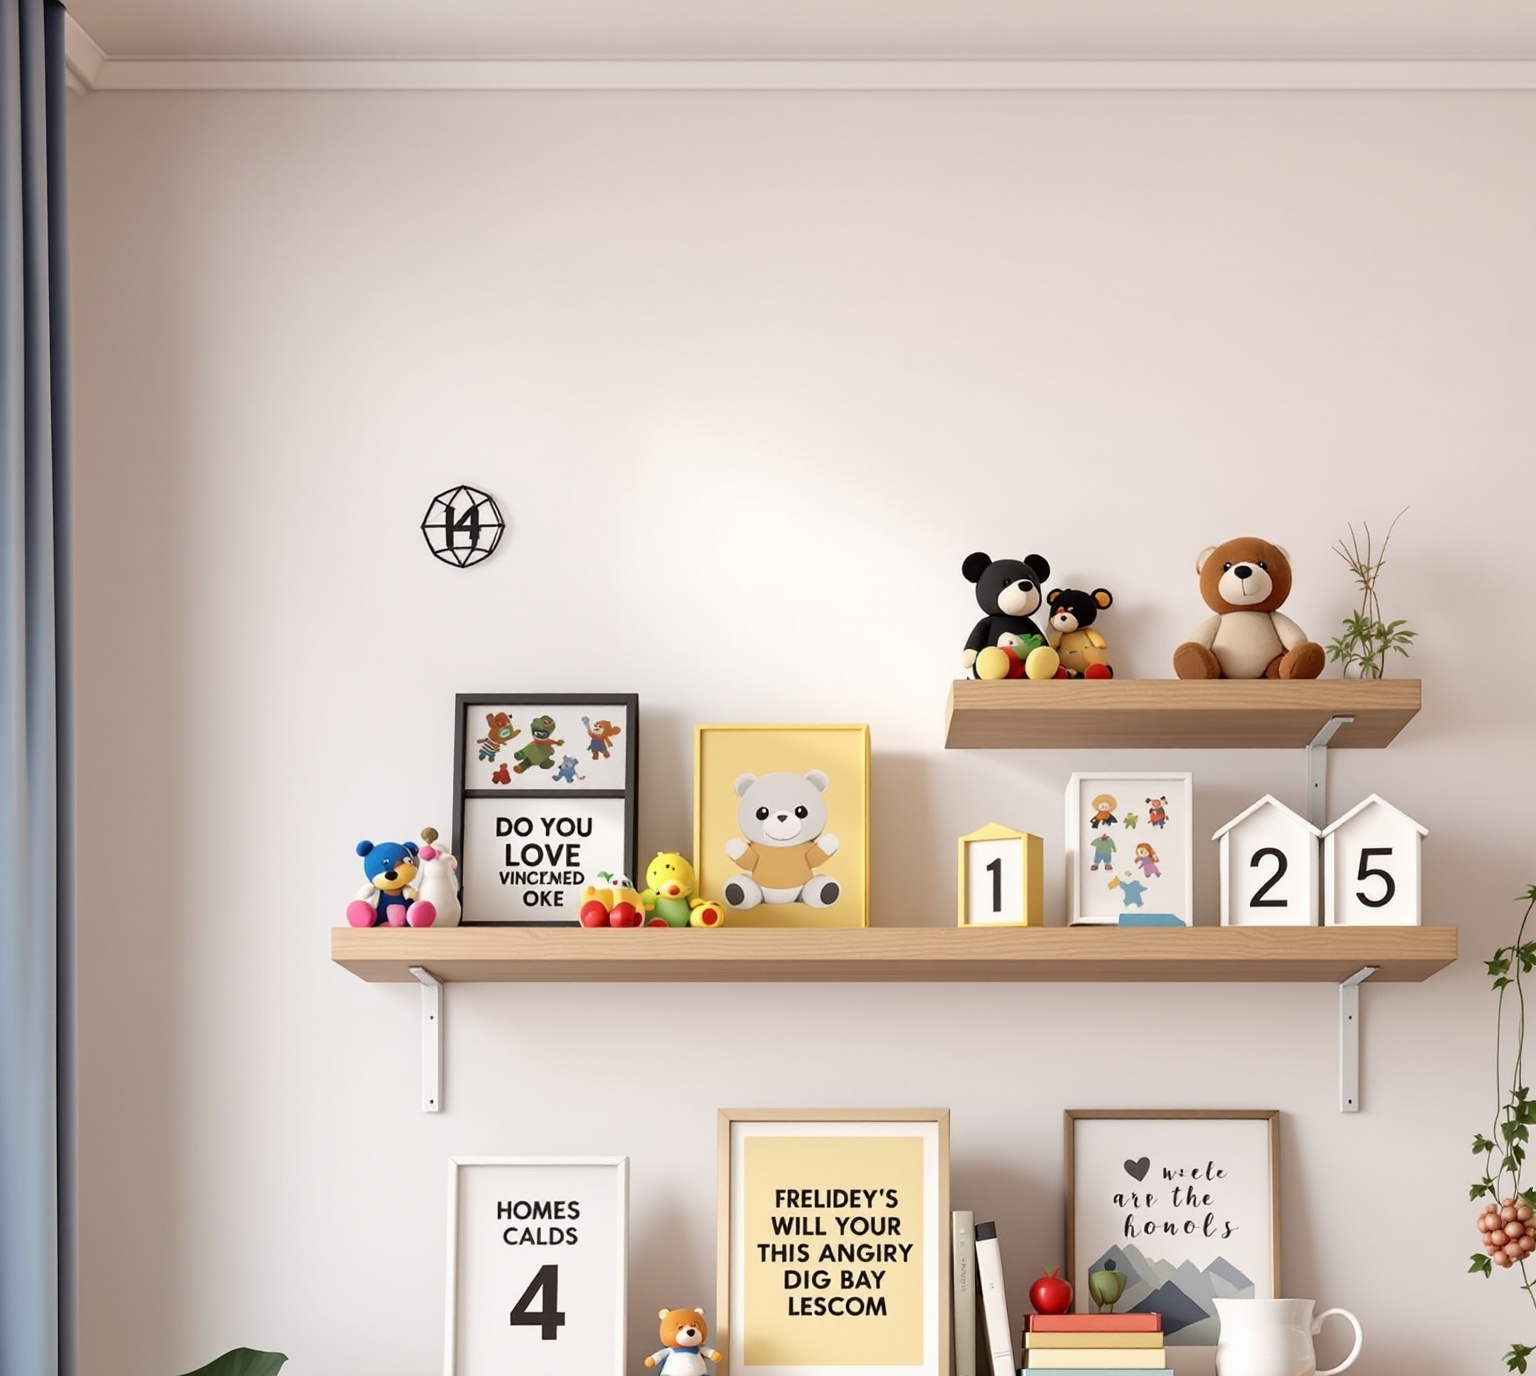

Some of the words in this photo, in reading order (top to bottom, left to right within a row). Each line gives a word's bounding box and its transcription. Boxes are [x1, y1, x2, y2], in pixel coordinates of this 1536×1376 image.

[496, 817, 533, 837] DO
[540, 817, 593, 837] YOU
[505, 843, 581, 867] LOVE
[986, 858, 1001, 912] 1
[1250, 847, 1288, 907] 2
[1356, 848, 1396, 907] 5
[523, 890, 564, 906] OKE
[775, 1189, 899, 1208] FRELIDEY'S
[1171, 1185, 1214, 1208] the
[497, 1201, 581, 1220] HOMES
[503, 1227, 578, 1245] CALDS
[771, 1217, 827, 1236] WILL
[835, 1216, 901, 1236] YOUR
[757, 1243, 810, 1262] THIS
[784, 1270, 831, 1289] DIG
[840, 1270, 886, 1289] BAY
[510, 1264, 565, 1340] 4
[788, 1297, 887, 1316] LESCOM
